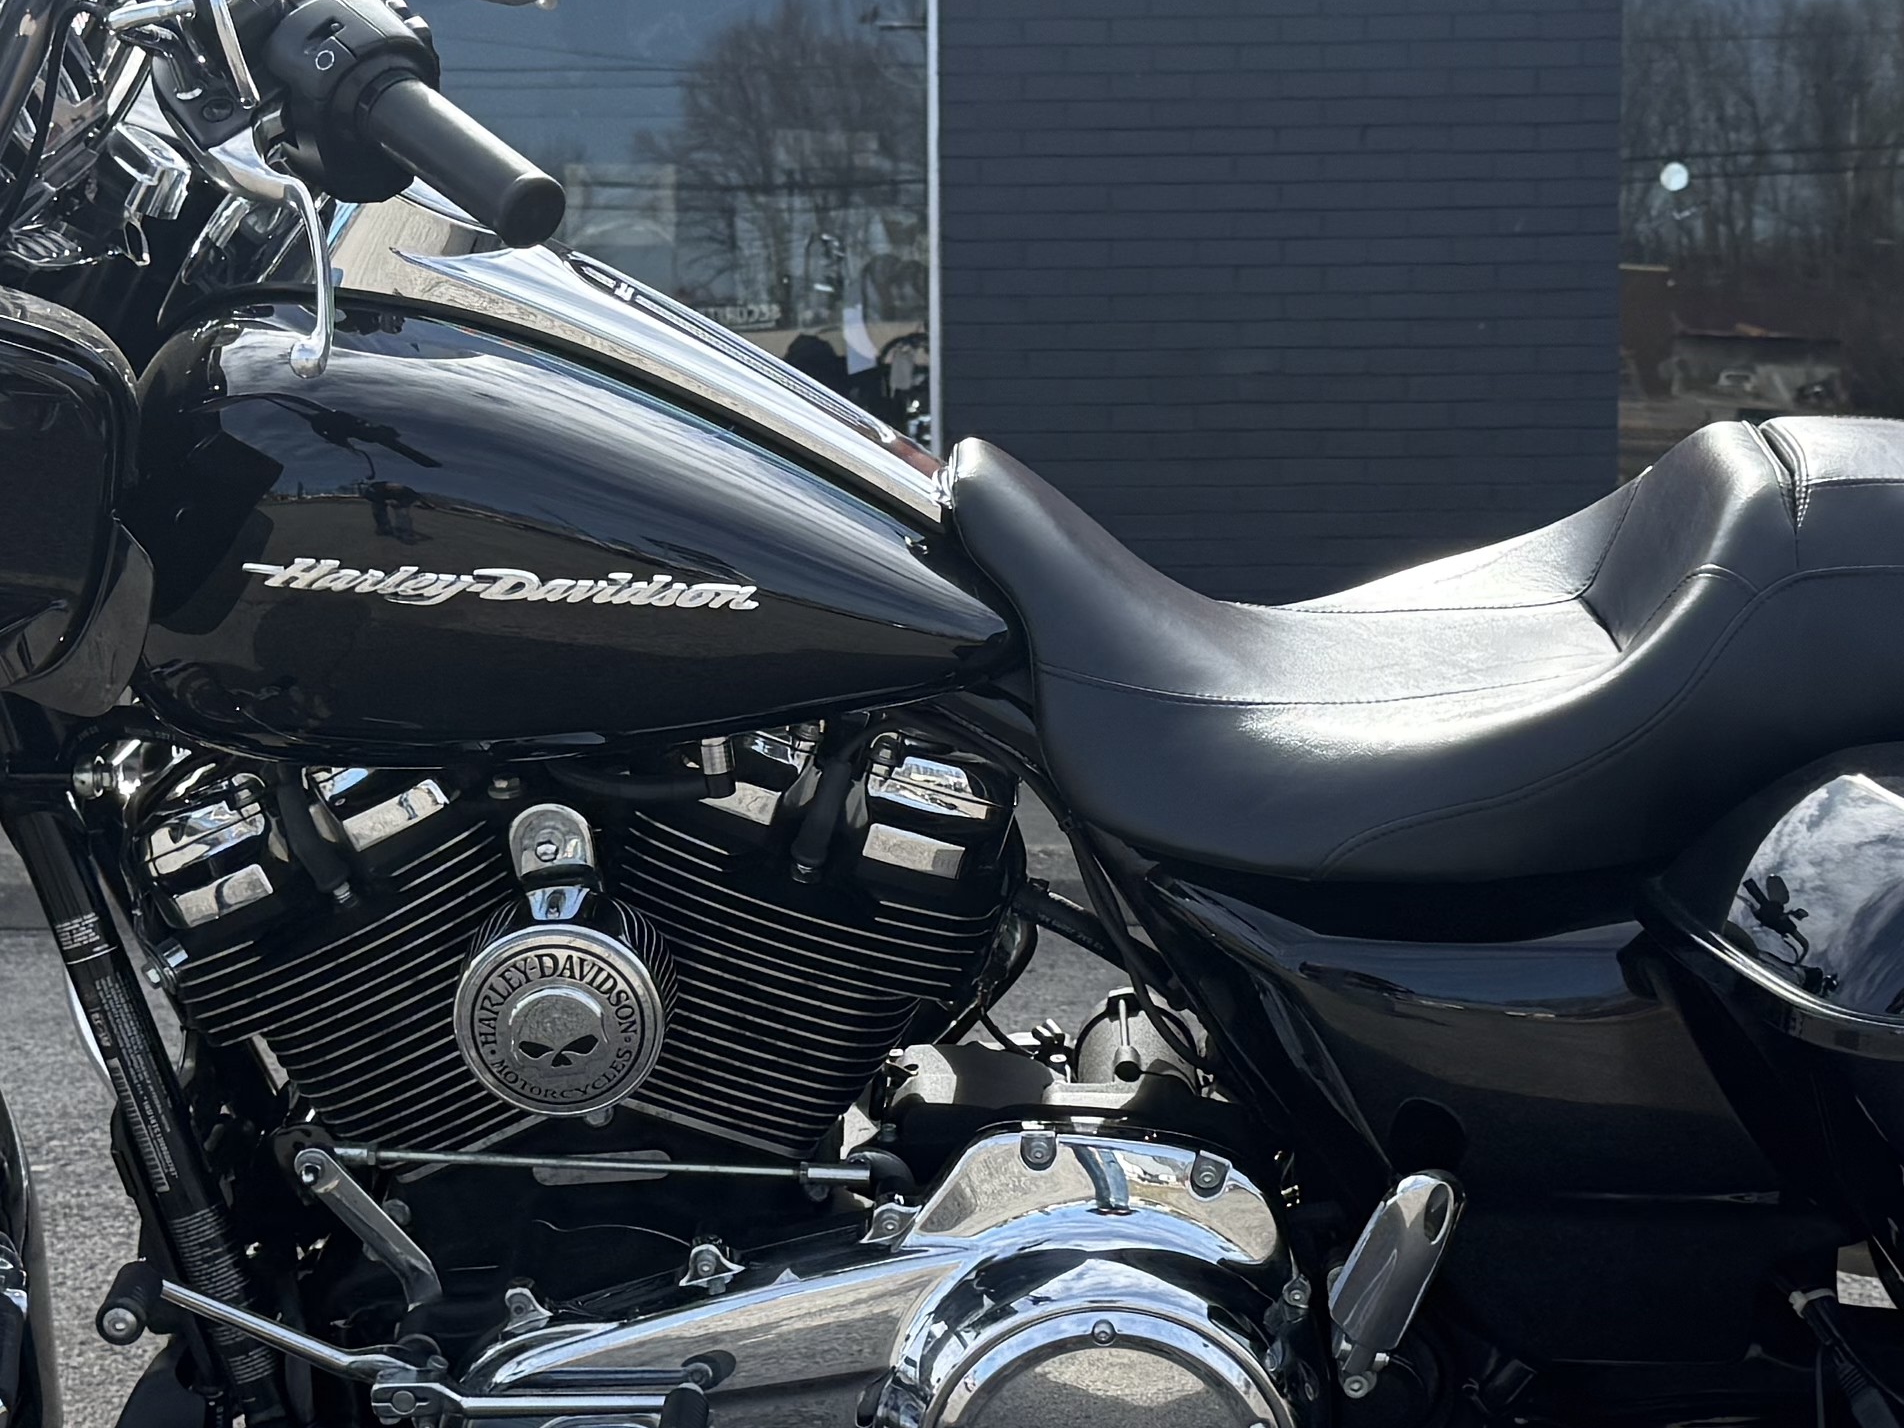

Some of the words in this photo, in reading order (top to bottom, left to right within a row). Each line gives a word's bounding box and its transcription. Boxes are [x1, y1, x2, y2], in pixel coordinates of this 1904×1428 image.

[242, 557, 760, 610] Harley-Davidson
[478, 952, 637, 1047] HARLEY-DAVIDSON
[492, 1047, 633, 1099] MOTORCYCLES
